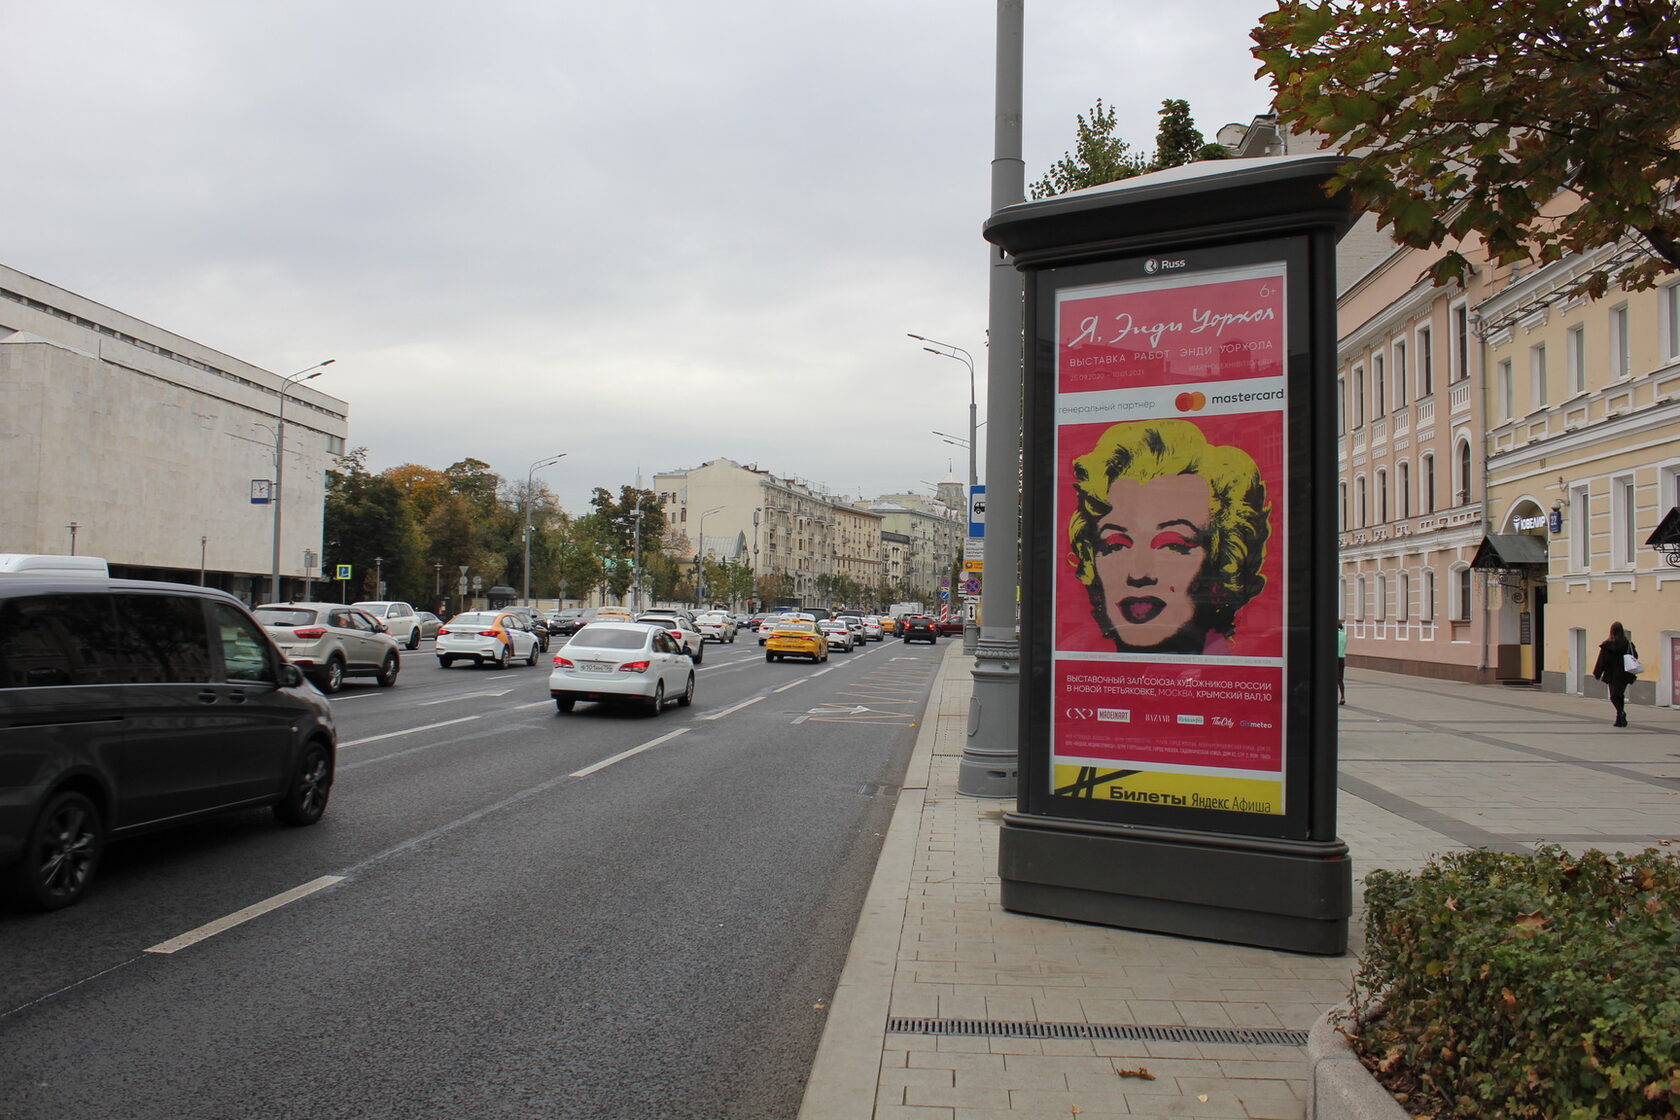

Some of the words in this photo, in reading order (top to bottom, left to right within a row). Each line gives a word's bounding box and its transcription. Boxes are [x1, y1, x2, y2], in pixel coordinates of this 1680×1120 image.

[1161, 260, 1186, 269] Russ
[1259, 283, 1276, 298] 6+
[1067, 315, 1102, 347] Я,
[1109, 313, 1182, 348] Энди
[1190, 308, 1275, 336] Уорхол
[1069, 354, 1126, 367] ВЫСТАВКА
[1134, 350, 1170, 361] РАБОТ
[1180, 346, 1213, 357] ЭНДИ
[1219, 340, 1273, 353] УОРХОЛА
[1211, 389, 1284, 404] mastercard
[1058, 403, 1116, 415] генеральный
[1066, 674, 1126, 685] ВЫСТАВОЧНЫЙ
[1126, 677, 1143, 685] ЗАЛ
[1143, 677, 1175, 687] СОЮЗА
[1176, 679, 1233, 690] ХУДОЖНИКОВ
[1234, 681, 1272, 691] РОССИИ
[1066, 684, 1073, 692] В
[1073, 684, 1102, 693] НОВОЙ
[1103, 686, 1157, 697] ТРЕТЬЯКОВКЕ,
[1158, 688, 1195, 699] МОСКВА,
[1196, 690, 1243, 700] КРЫМСКИЙ
[1110, 785, 1186, 805] Билеты
[1191, 792, 1230, 810] Яндекс
[1231, 796, 1272, 813] Афиша
